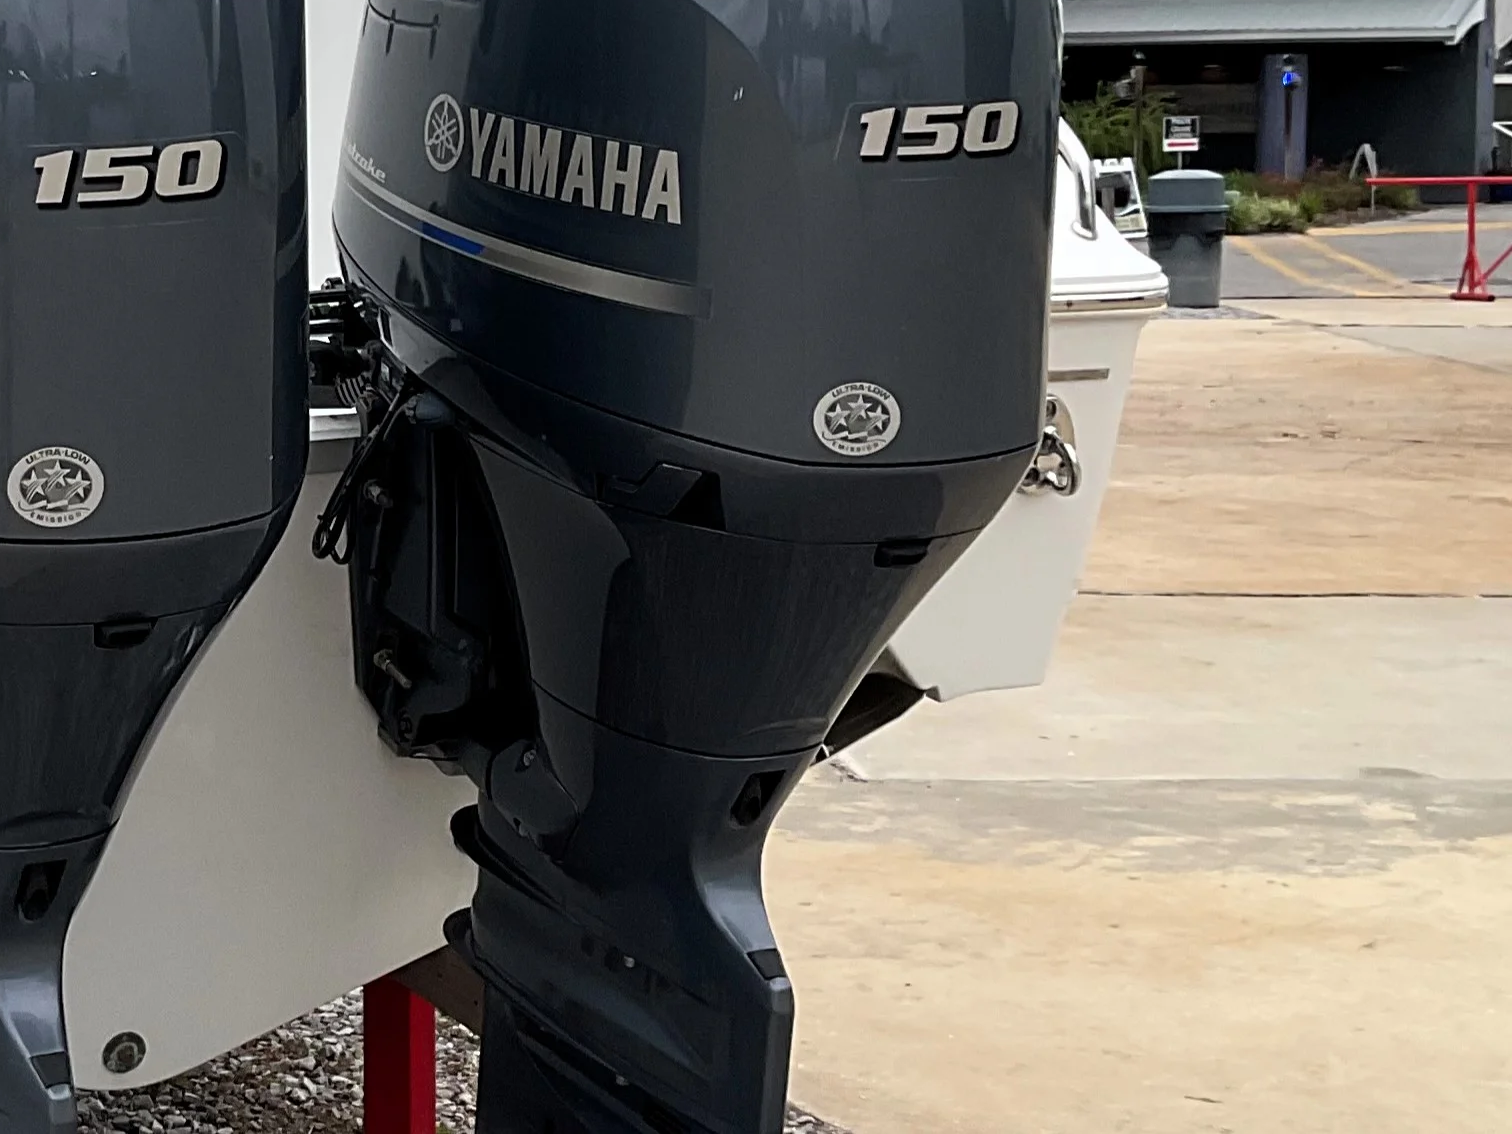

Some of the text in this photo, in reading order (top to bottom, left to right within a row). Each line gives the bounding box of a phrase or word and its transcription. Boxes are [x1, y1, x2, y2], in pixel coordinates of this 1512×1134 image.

[860, 101, 1019, 157] 150
[34, 139, 223, 204] 150
[472, 108, 682, 225] YAMAHA
